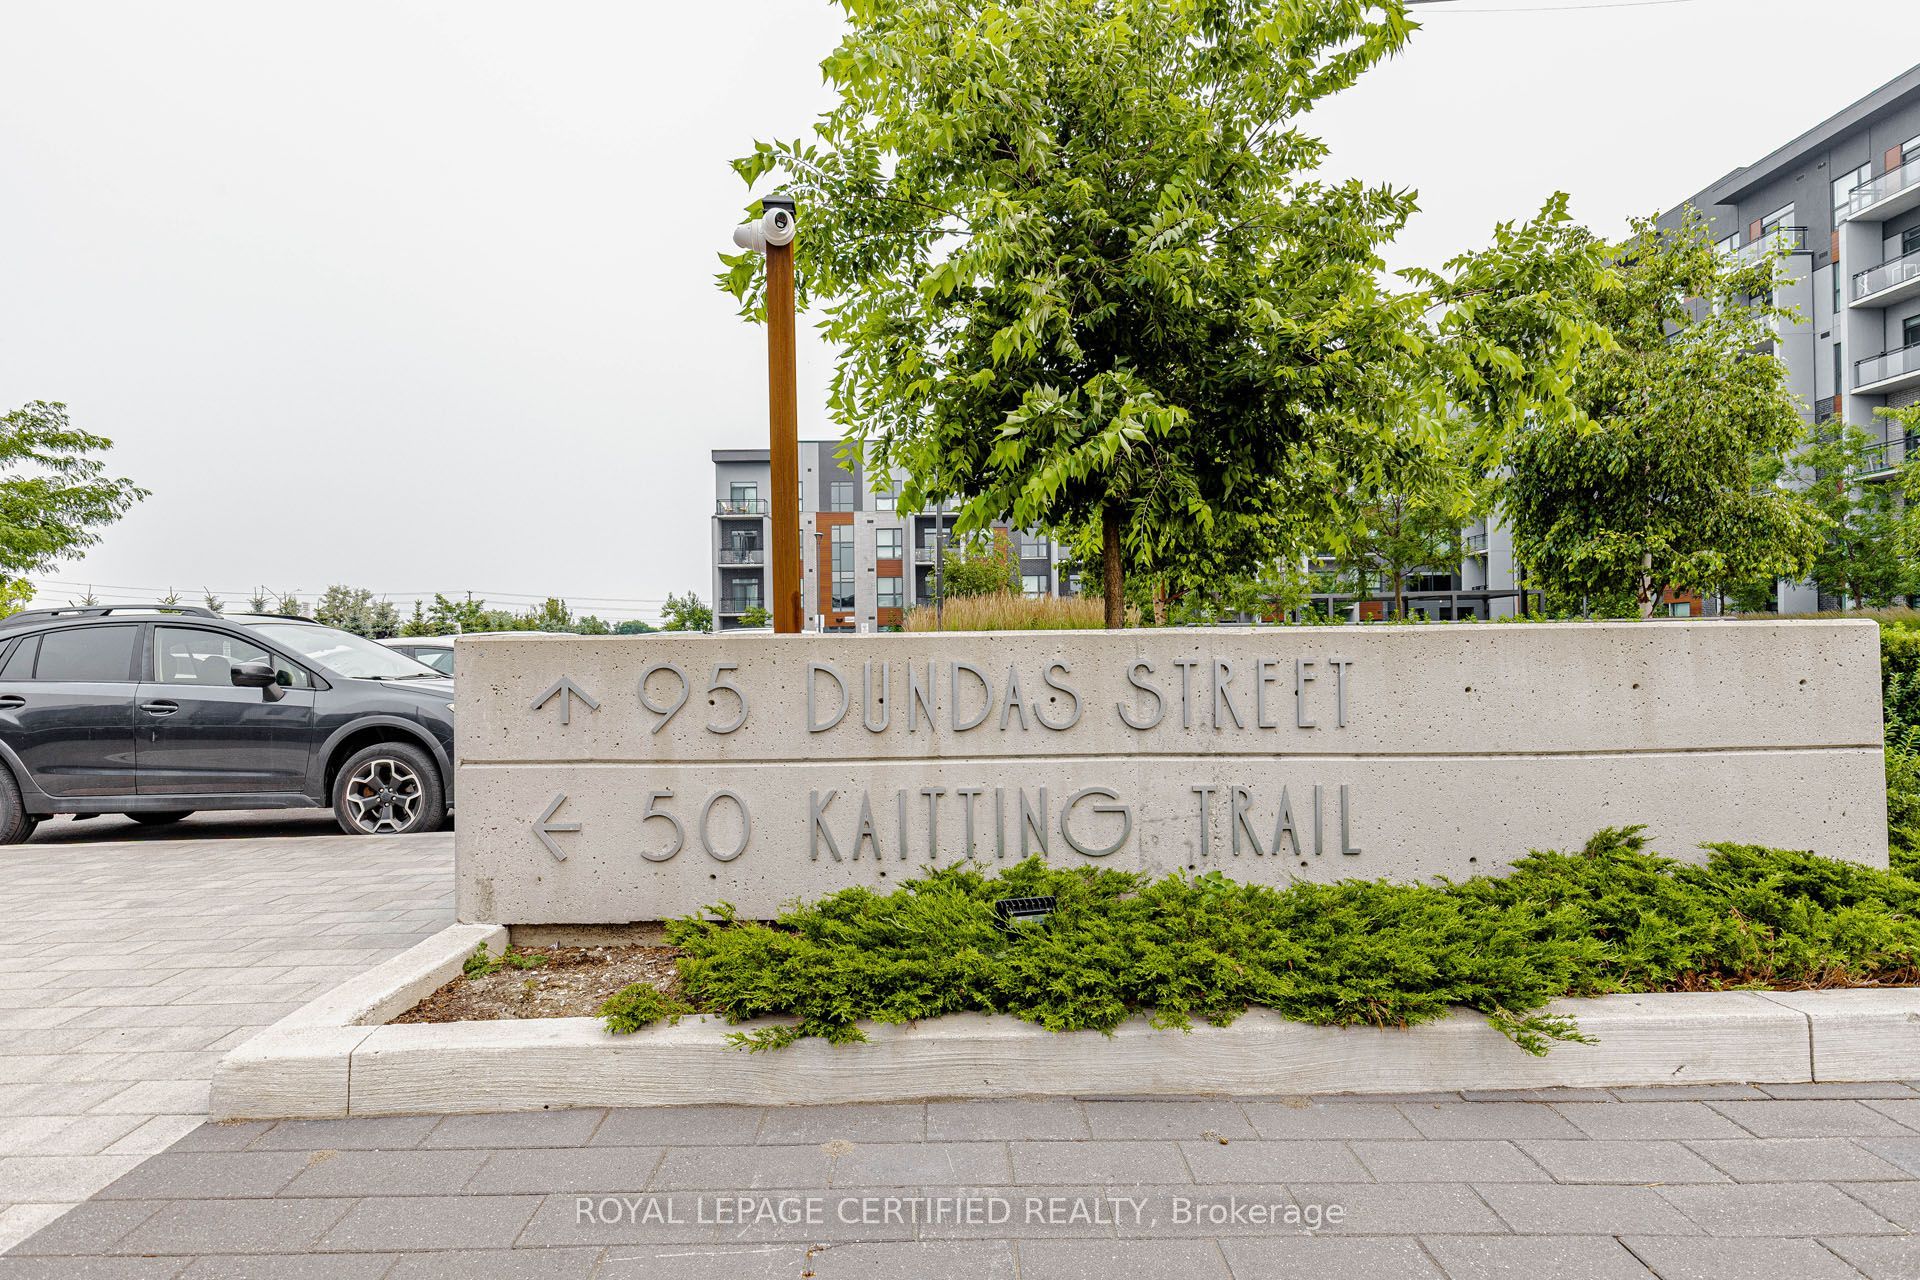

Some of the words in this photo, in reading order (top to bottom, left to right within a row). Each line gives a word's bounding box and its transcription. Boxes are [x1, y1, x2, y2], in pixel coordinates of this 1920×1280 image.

[638, 662, 749, 734] 95
[807, 659, 1083, 733] DUNDAS
[1116, 657, 1352, 730] STREET
[641, 789, 751, 862] 50
[810, 786, 1133, 861] KAITTING
[1192, 784, 1362, 856] TRAIL
